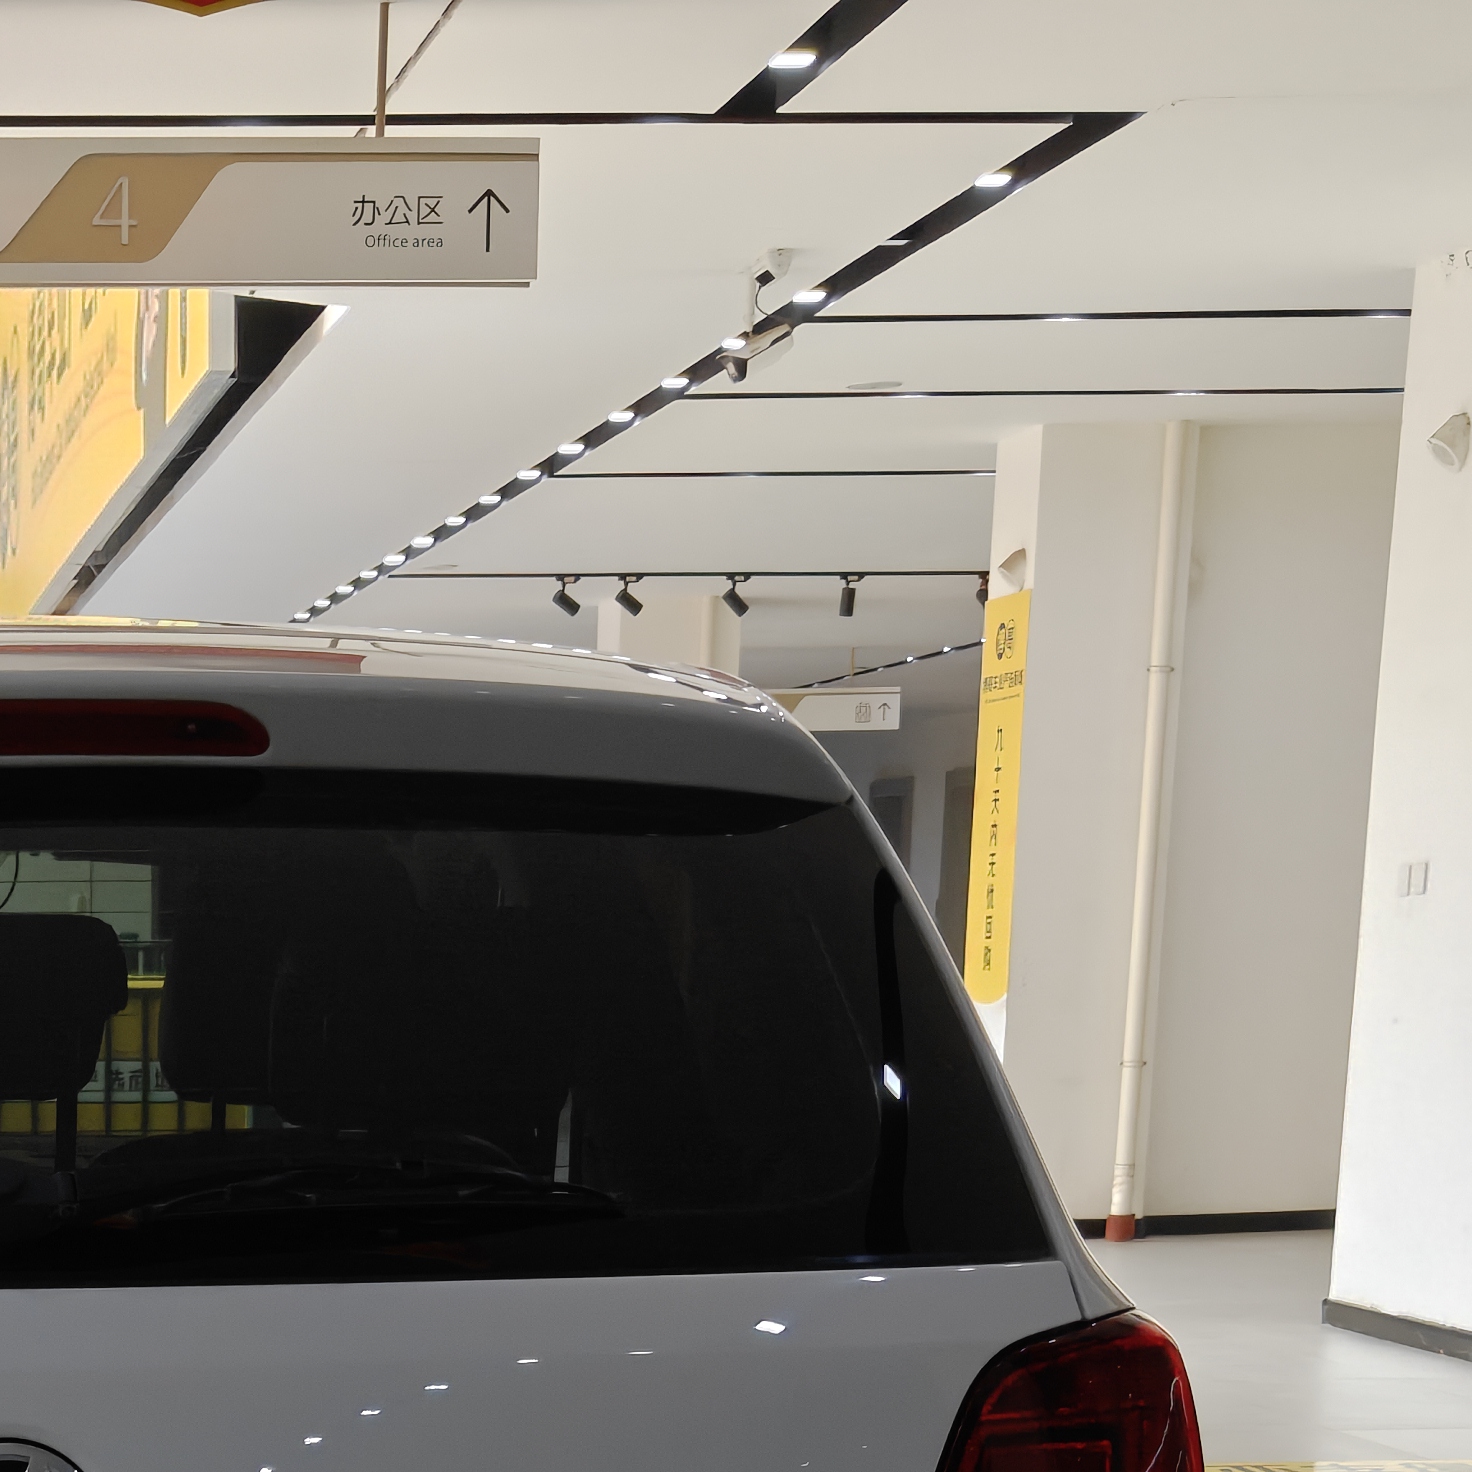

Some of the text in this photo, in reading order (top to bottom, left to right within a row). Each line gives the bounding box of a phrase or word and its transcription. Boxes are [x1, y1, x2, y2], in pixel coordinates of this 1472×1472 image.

[92, 176, 138, 245] 4
[352, 195, 445, 226] 办公区
[365, 234, 444, 249] Office area
